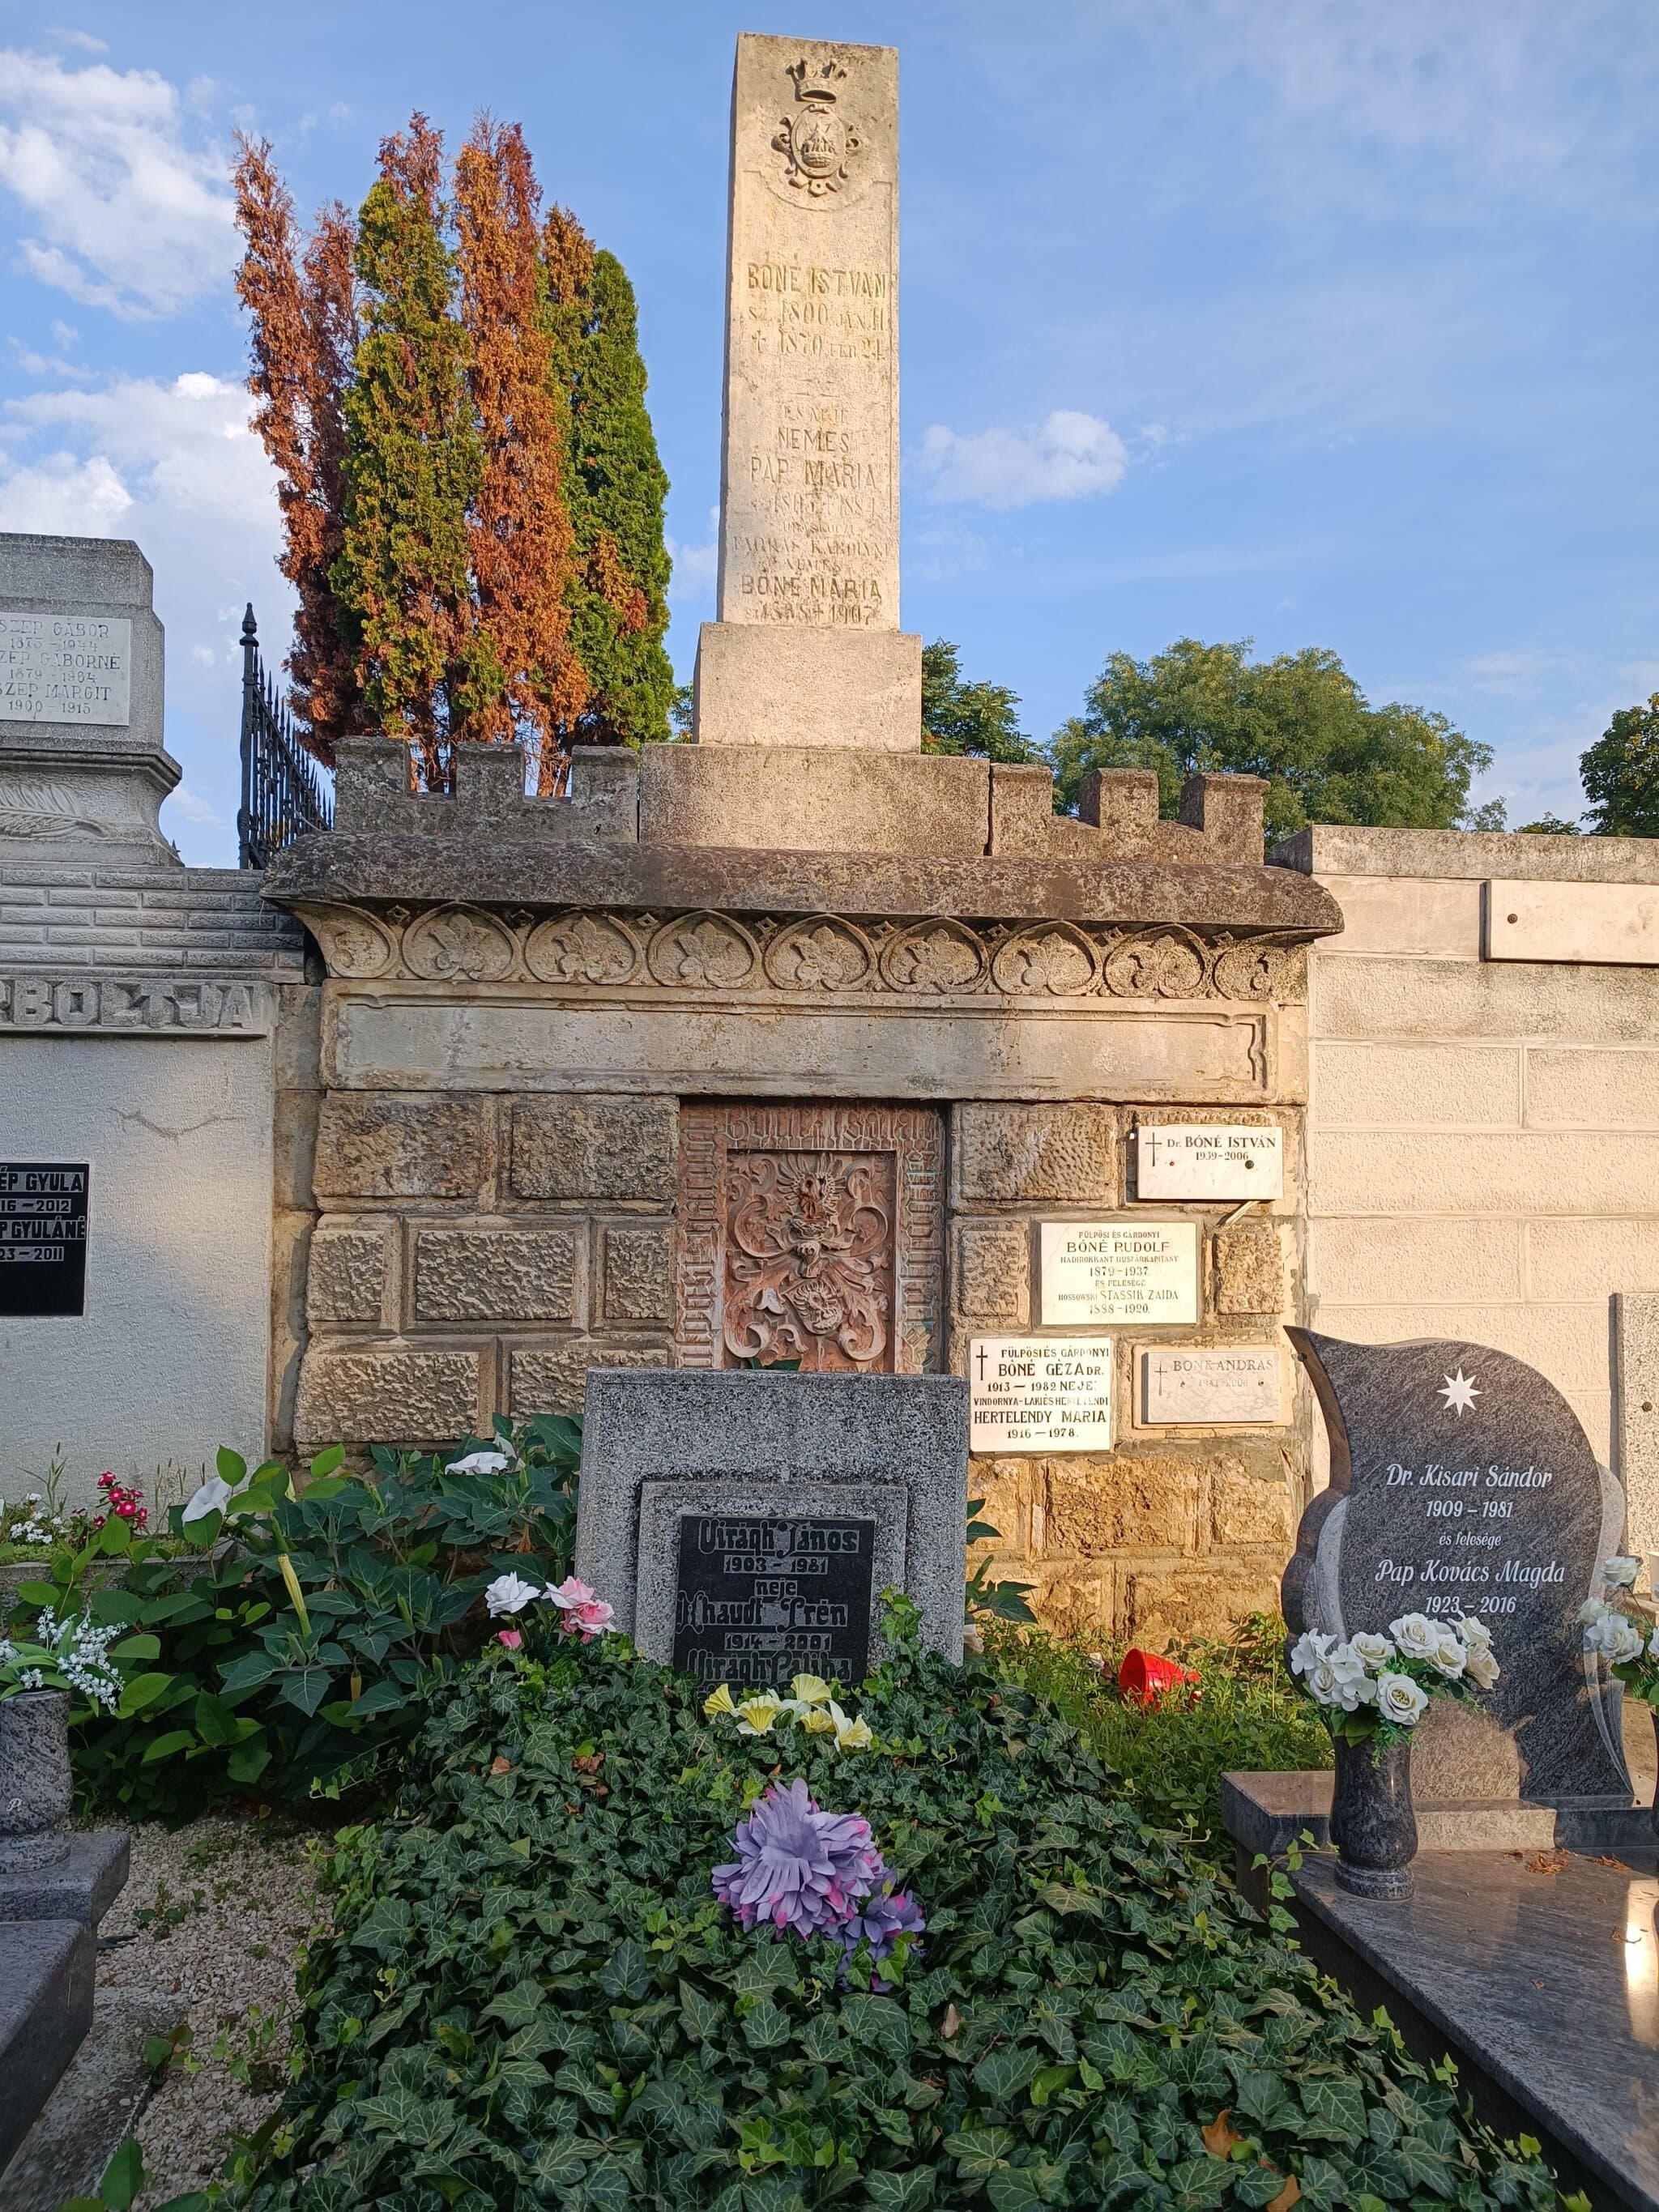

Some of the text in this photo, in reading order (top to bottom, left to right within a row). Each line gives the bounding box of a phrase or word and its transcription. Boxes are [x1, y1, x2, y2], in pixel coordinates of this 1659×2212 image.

[777, 426, 850, 454] NEMES
[9, 699, 43, 713] 1900
[62, 701, 91, 714] 1915
[0, 978, 254, 1029] BOLTJA
[1185, 1135, 1222, 1148] BÓNÉ
[1228, 1135, 1276, 1149] ISTVÁN
[26, 1173, 83, 1191] GYULA
[36, 1200, 70, 1212] 2012
[11, 1216, 85, 1239] GYULÁNÉ
[1067, 1239, 1170, 1253] BÓNÉ RUDOLF
[998, 1359, 1036, 1377] BÓNÉ
[1046, 1359, 1085, 1376] GÉZA
[987, 1382, 1010, 1392] 1913
[1030, 1382, 1057, 1392] 1982
[974, 1411, 1052, 1424] HERTELENDY
[1386, 1464, 1552, 1487] Dr. Kisari Sándor
[1426, 1500, 1463, 1517] 1909
[1482, 1502, 1513, 1518] 1981
[1439, 1532, 1502, 1549] és felesége
[725, 1557, 766, 1573] 1903
[791, 1558, 826, 1573] 1981
[1375, 1559, 1565, 1589] Pap Kovács Magda
[756, 1579, 796, 1602] neje
[1425, 1596, 1459, 1613] 1923
[1479, 1596, 1516, 1613] 2016
[725, 1634, 763, 1650] 1914
[784, 1635, 830, 1649] 2001
